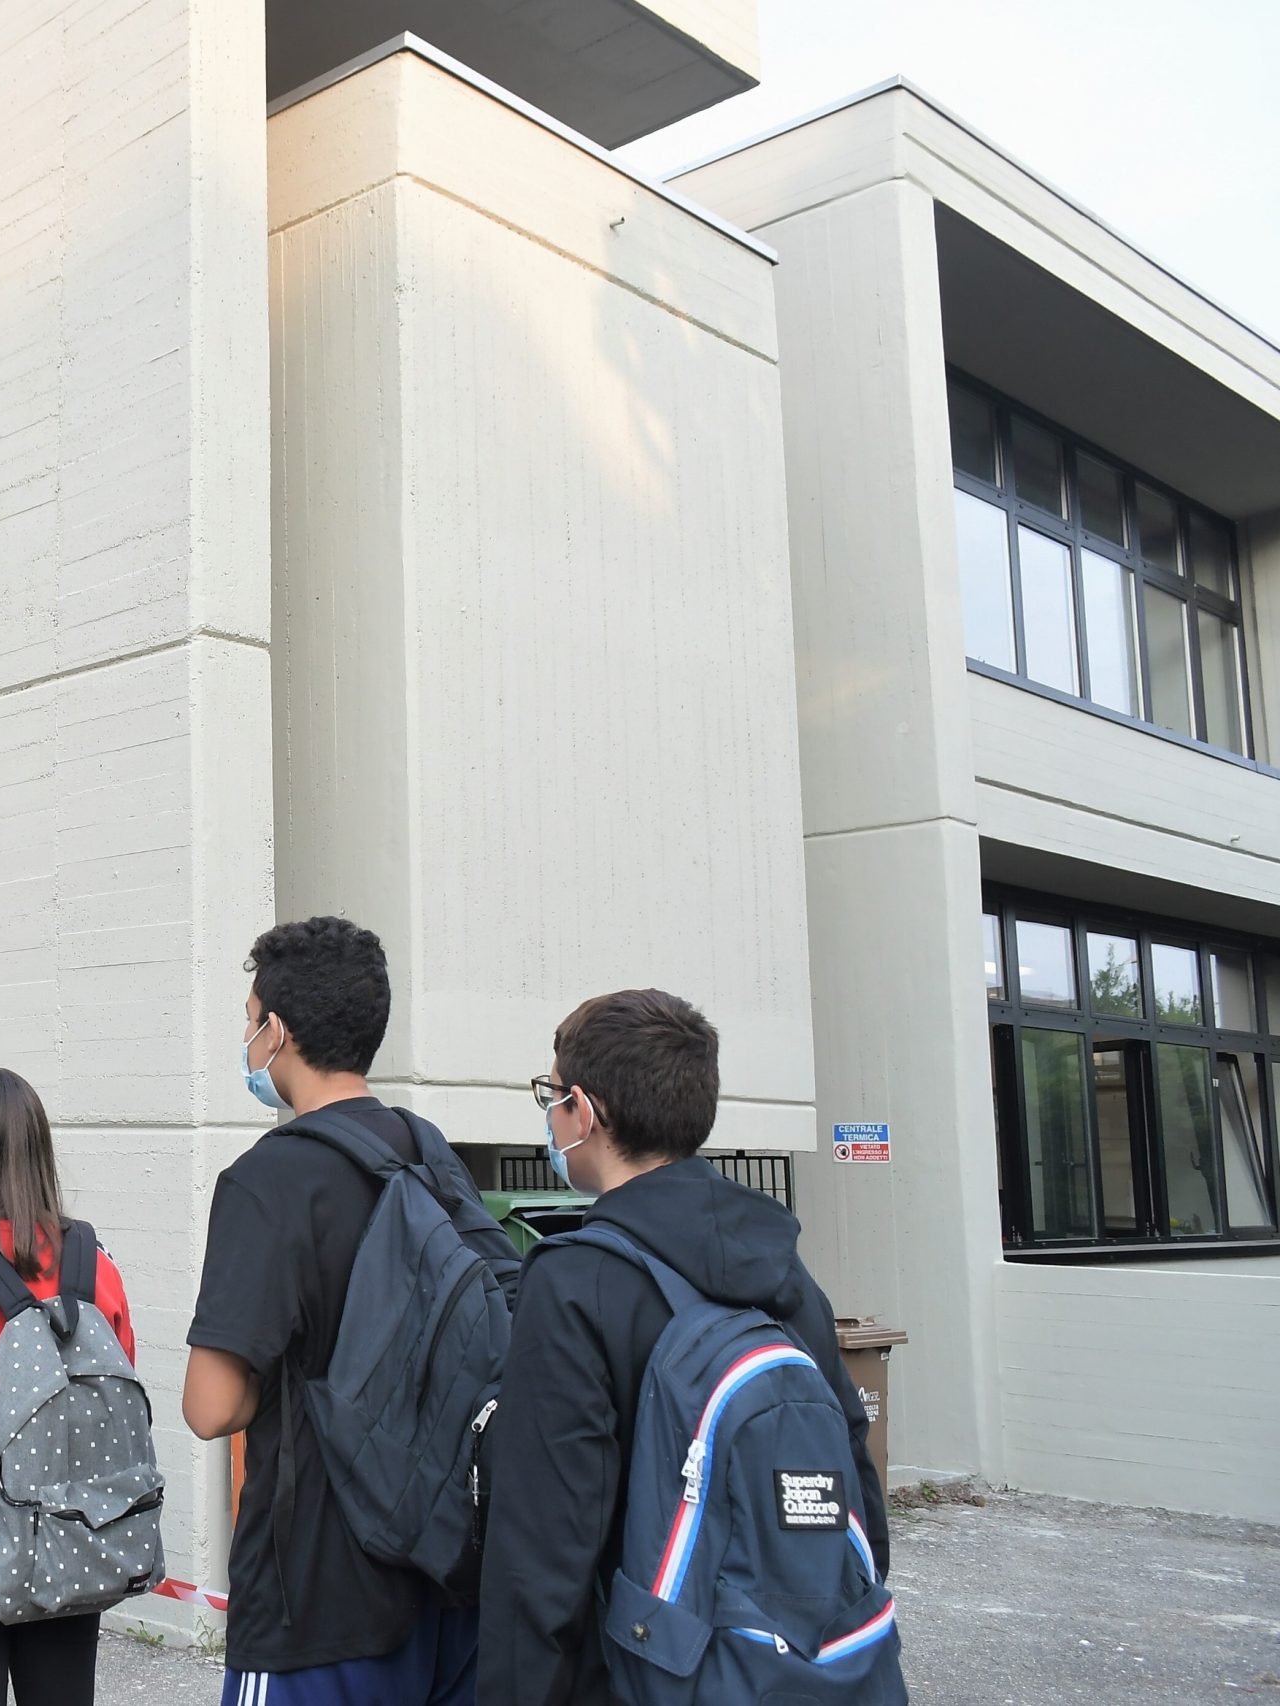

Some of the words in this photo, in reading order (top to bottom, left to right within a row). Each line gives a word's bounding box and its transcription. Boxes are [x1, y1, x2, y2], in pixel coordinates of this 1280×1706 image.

[838, 1125, 883, 1133] CENTRALE
[842, 1133, 880, 1141] TERMICA
[781, 1473, 833, 1491] Superdry
[782, 1486, 822, 1502] Japan
